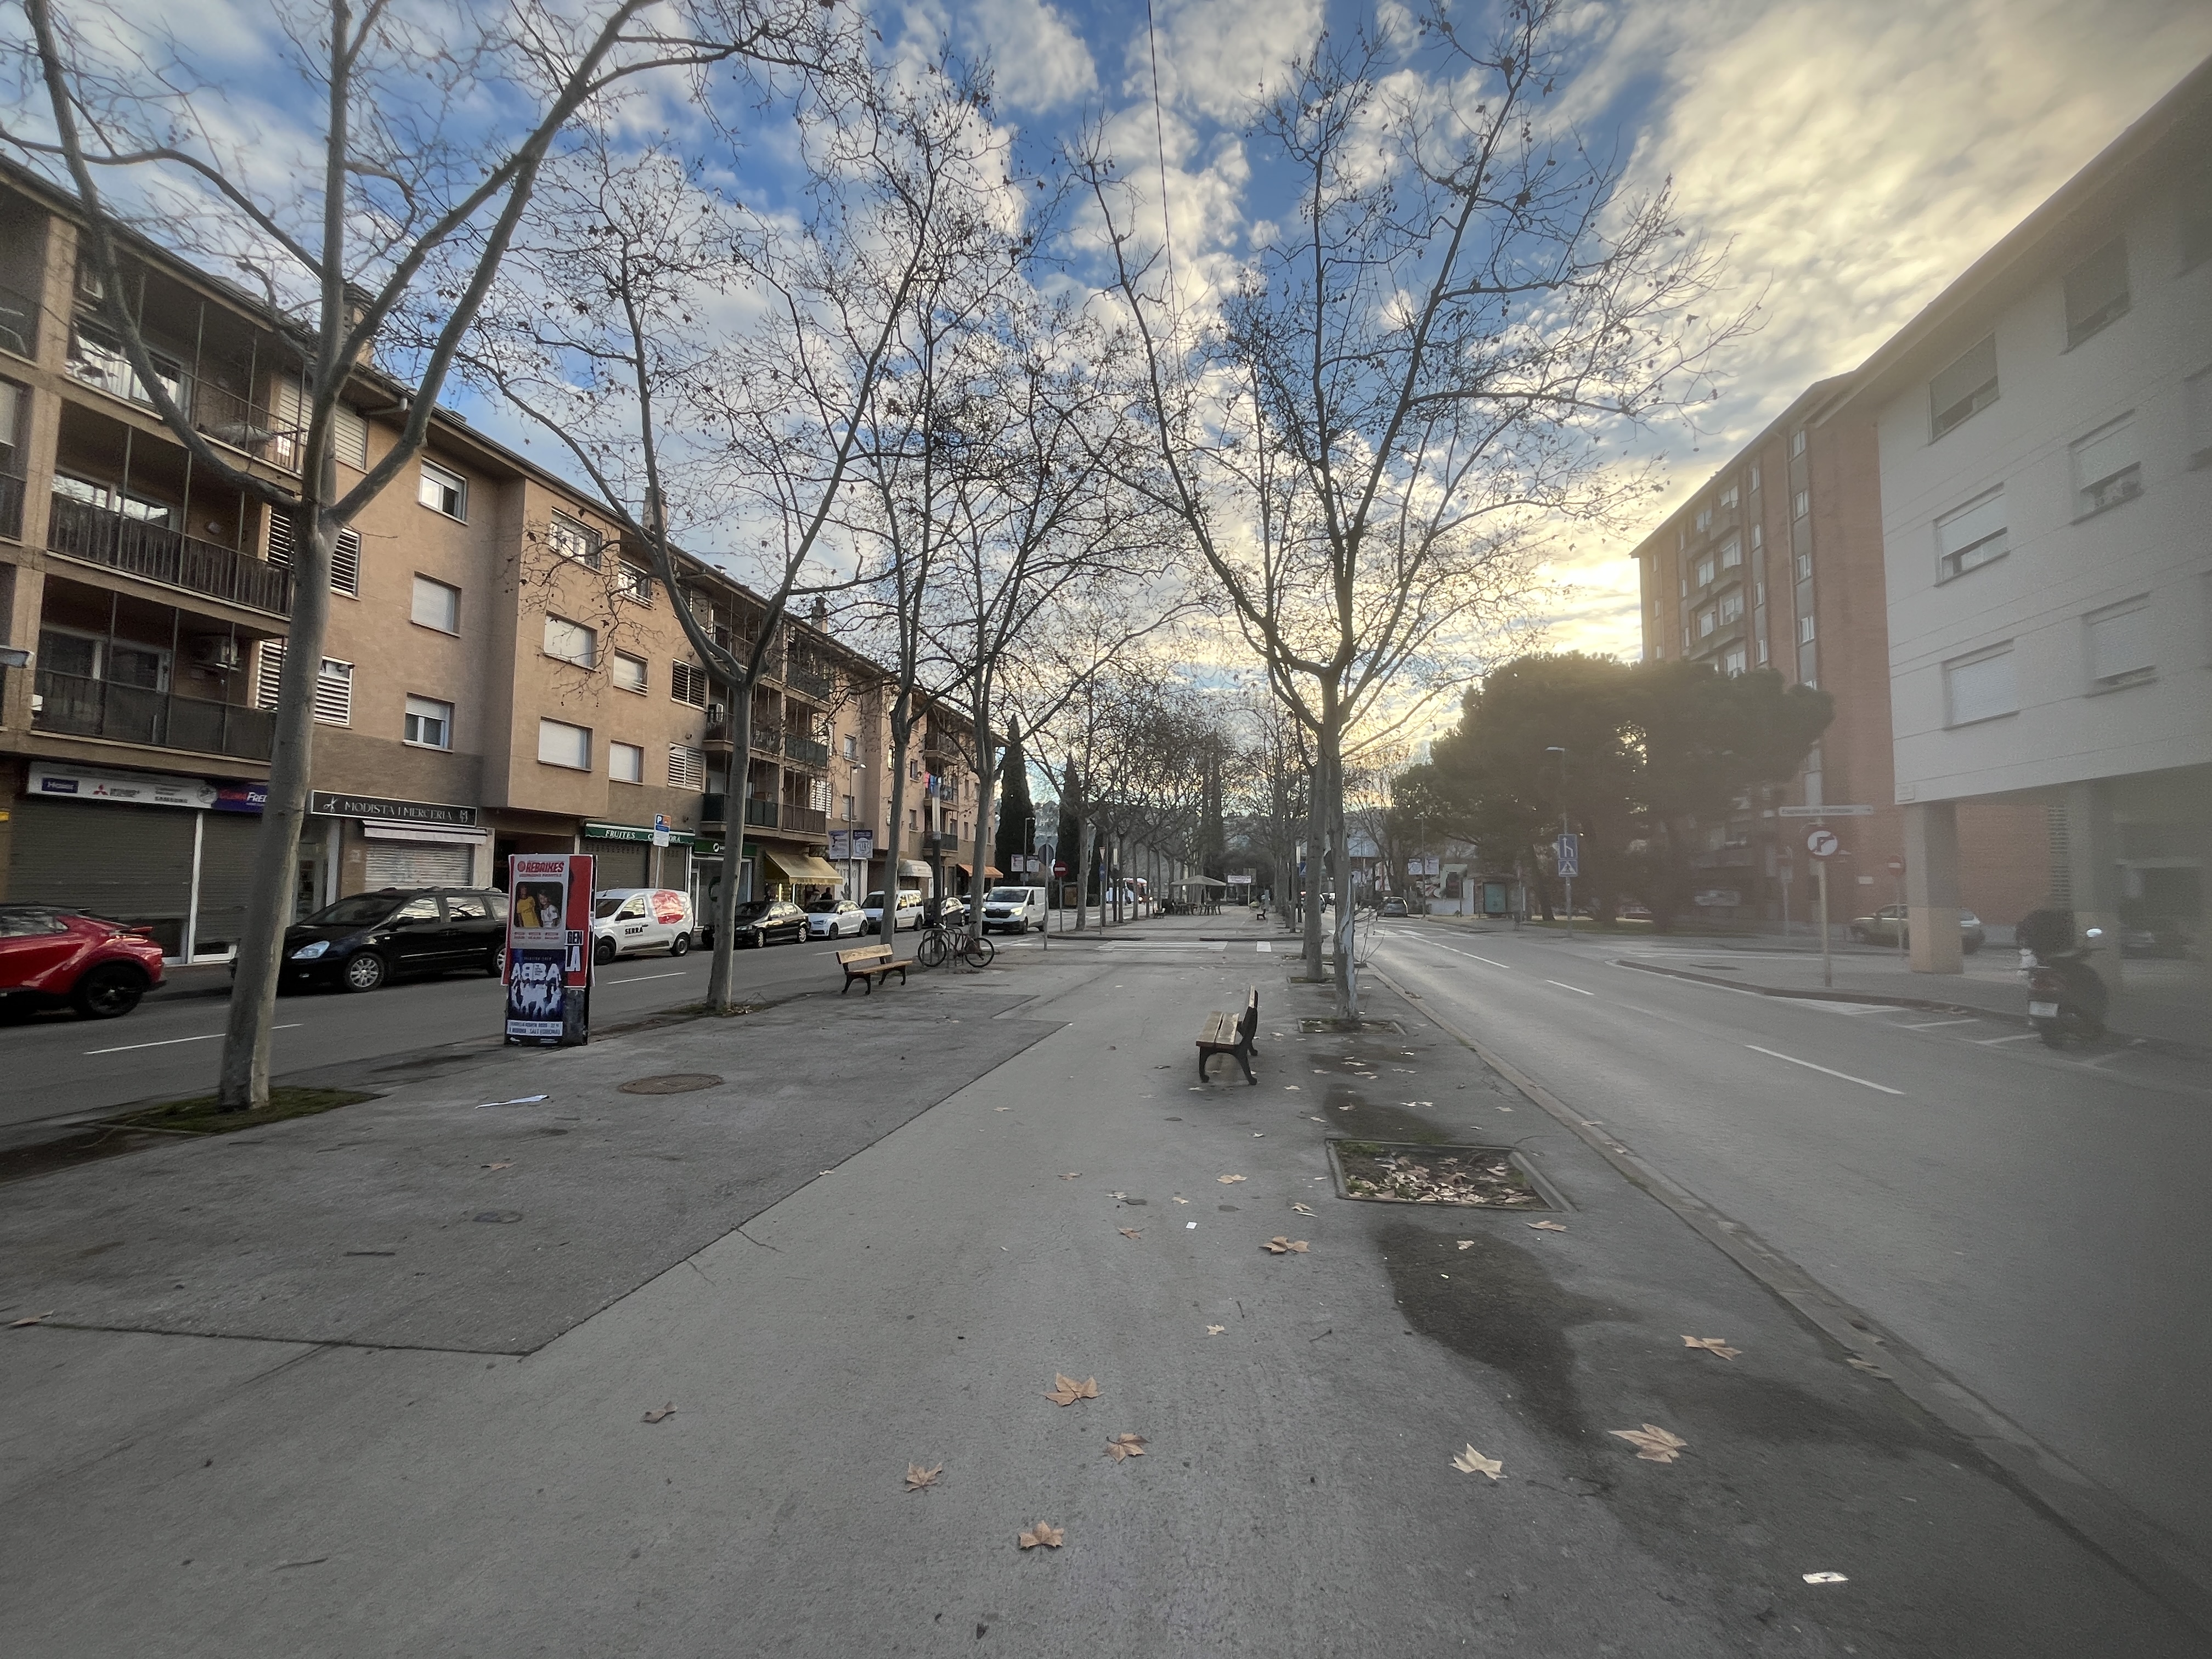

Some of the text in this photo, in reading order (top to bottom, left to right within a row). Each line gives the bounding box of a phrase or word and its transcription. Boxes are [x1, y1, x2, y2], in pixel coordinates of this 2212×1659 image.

[345, 801, 394, 815] MODISTA
[403, 806, 452, 820] MERCERIA
[605, 830, 635, 839] FRUITES
[526, 862, 565, 873] REBAIXES
[625, 927, 643, 935] SERRA
[511, 962, 561, 981] ABBA
